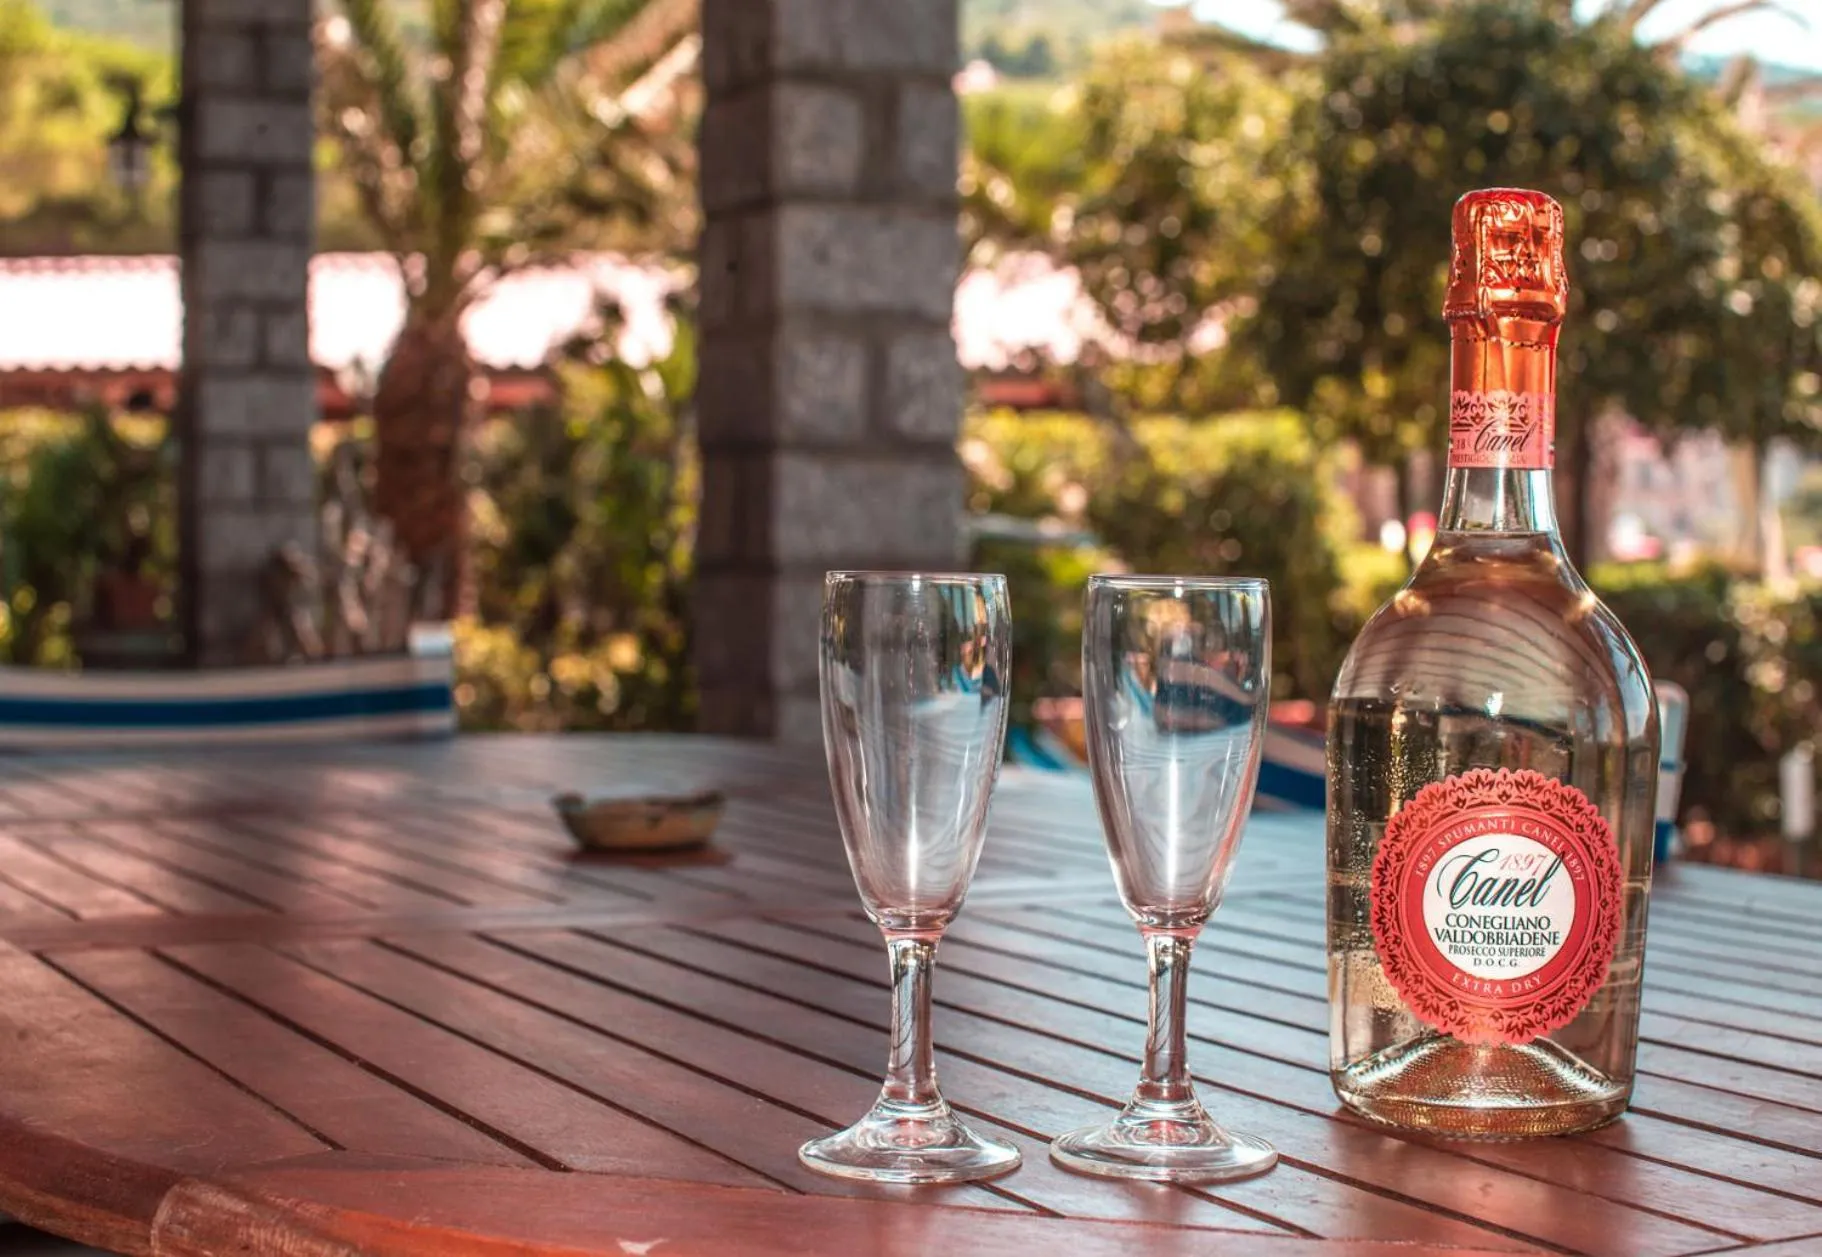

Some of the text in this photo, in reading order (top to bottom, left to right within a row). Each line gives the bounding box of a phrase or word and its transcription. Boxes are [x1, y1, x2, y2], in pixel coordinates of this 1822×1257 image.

[1474, 419, 1537, 453] Canel
[1438, 819, 1515, 847] SPUMANTI
[1521, 822, 1564, 853] CANEL
[1566, 852, 1585, 880] 1897
[1500, 853, 1548, 876] 1897
[1437, 848, 1565, 909] Canel
[1445, 913, 1551, 930] CONEGLIANO
[1434, 927, 1560, 946] VALDOBBIADENE
[1448, 944, 1546, 957] PROSECCO SUPERIORE
[1452, 972, 1541, 994] EXTRA DRY
